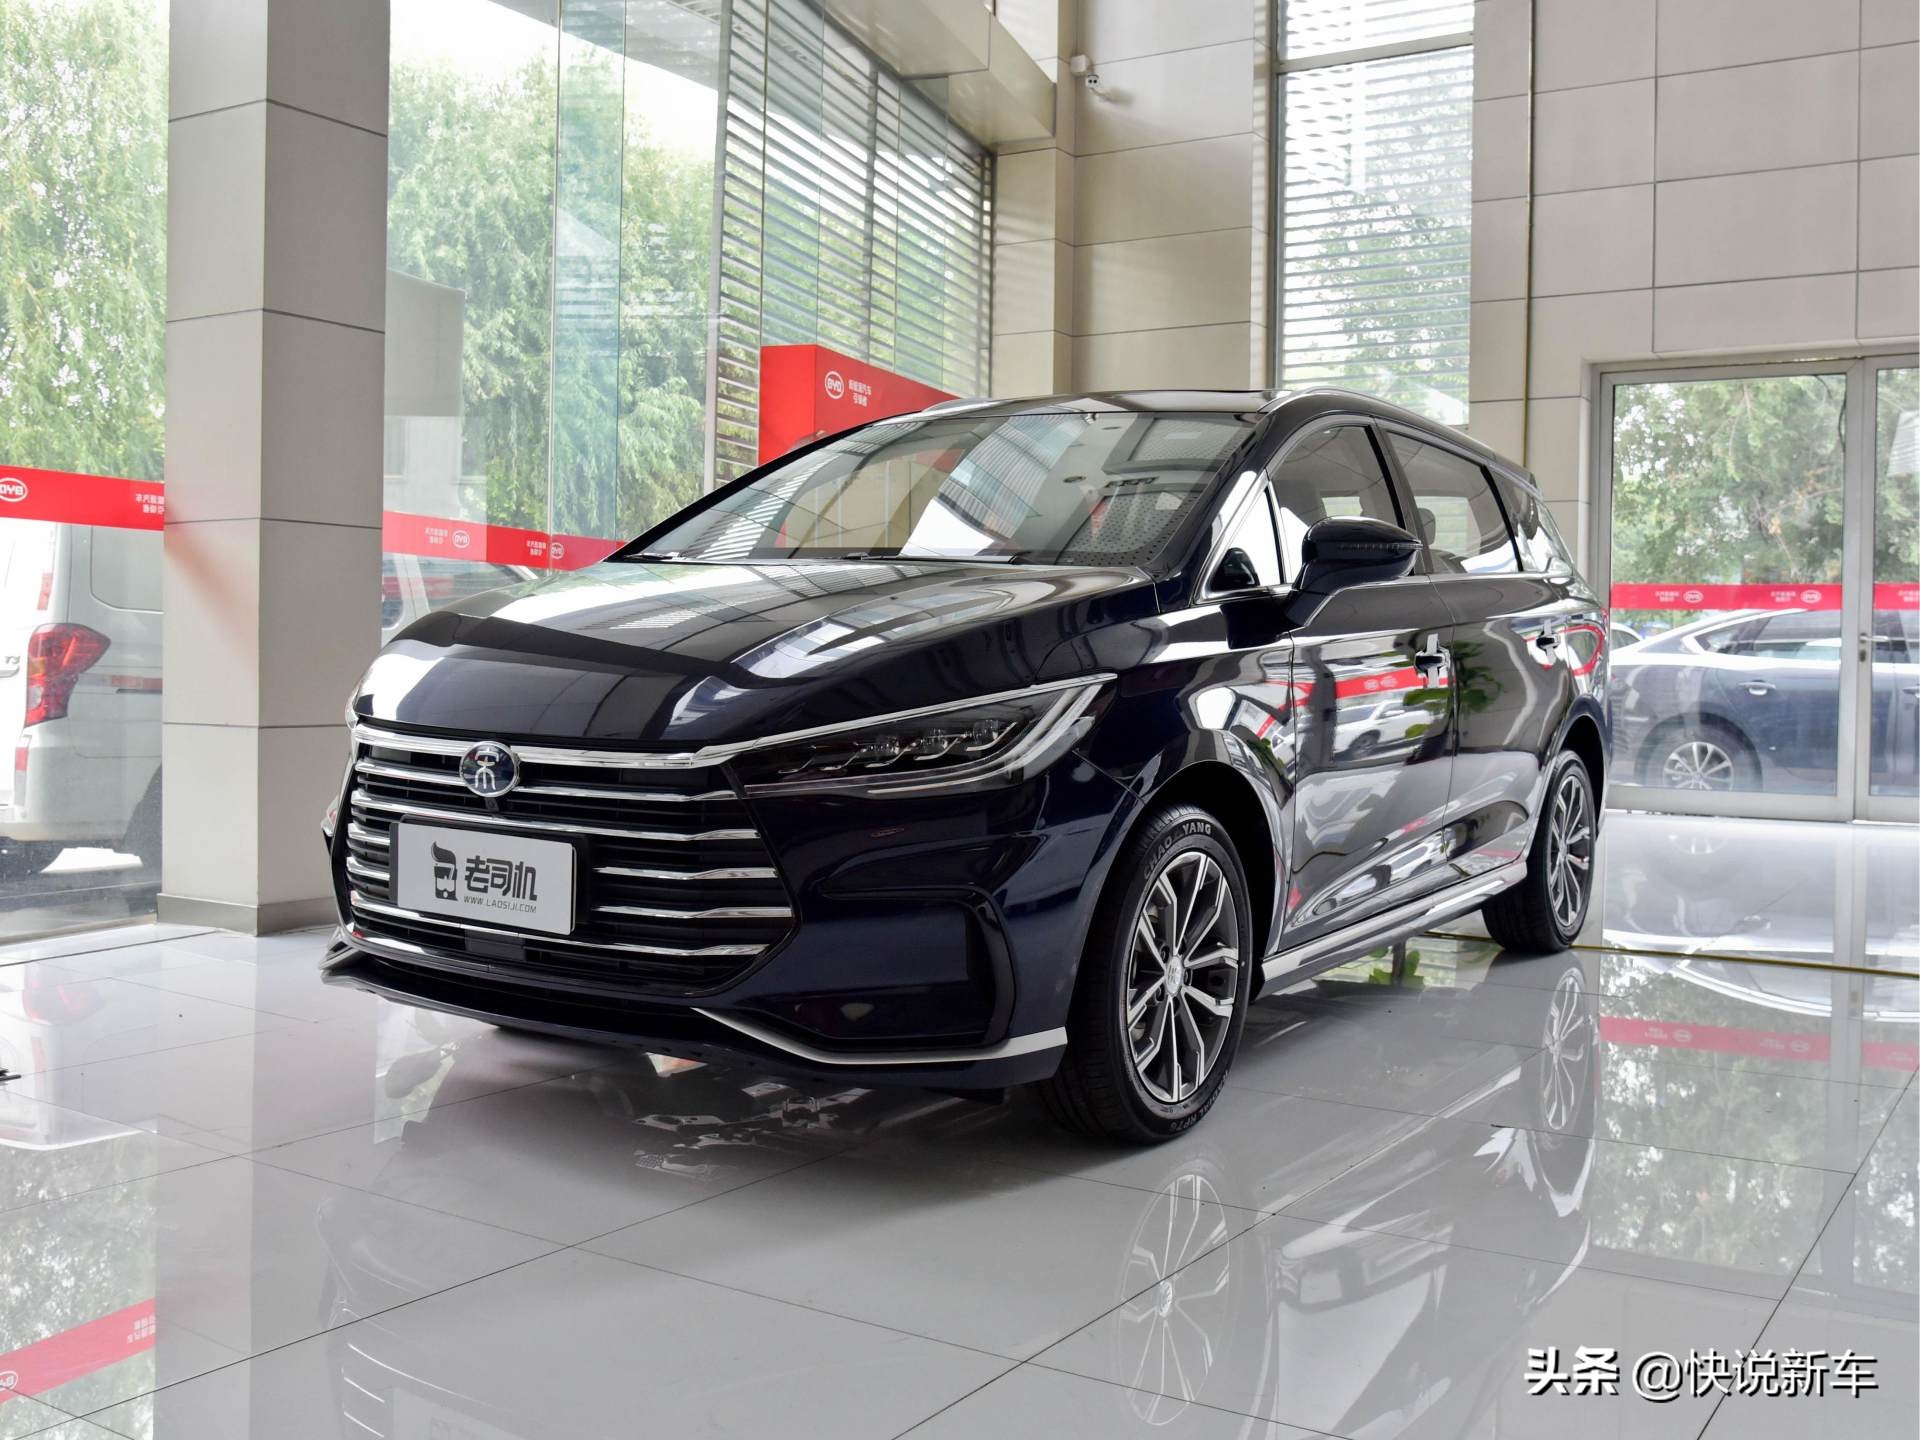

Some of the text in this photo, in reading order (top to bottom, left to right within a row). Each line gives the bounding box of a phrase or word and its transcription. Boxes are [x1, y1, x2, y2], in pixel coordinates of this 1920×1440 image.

[827, 377, 842, 393] BYD
[1182, 822, 1211, 835] YANG
[465, 855, 538, 901] 老司机
